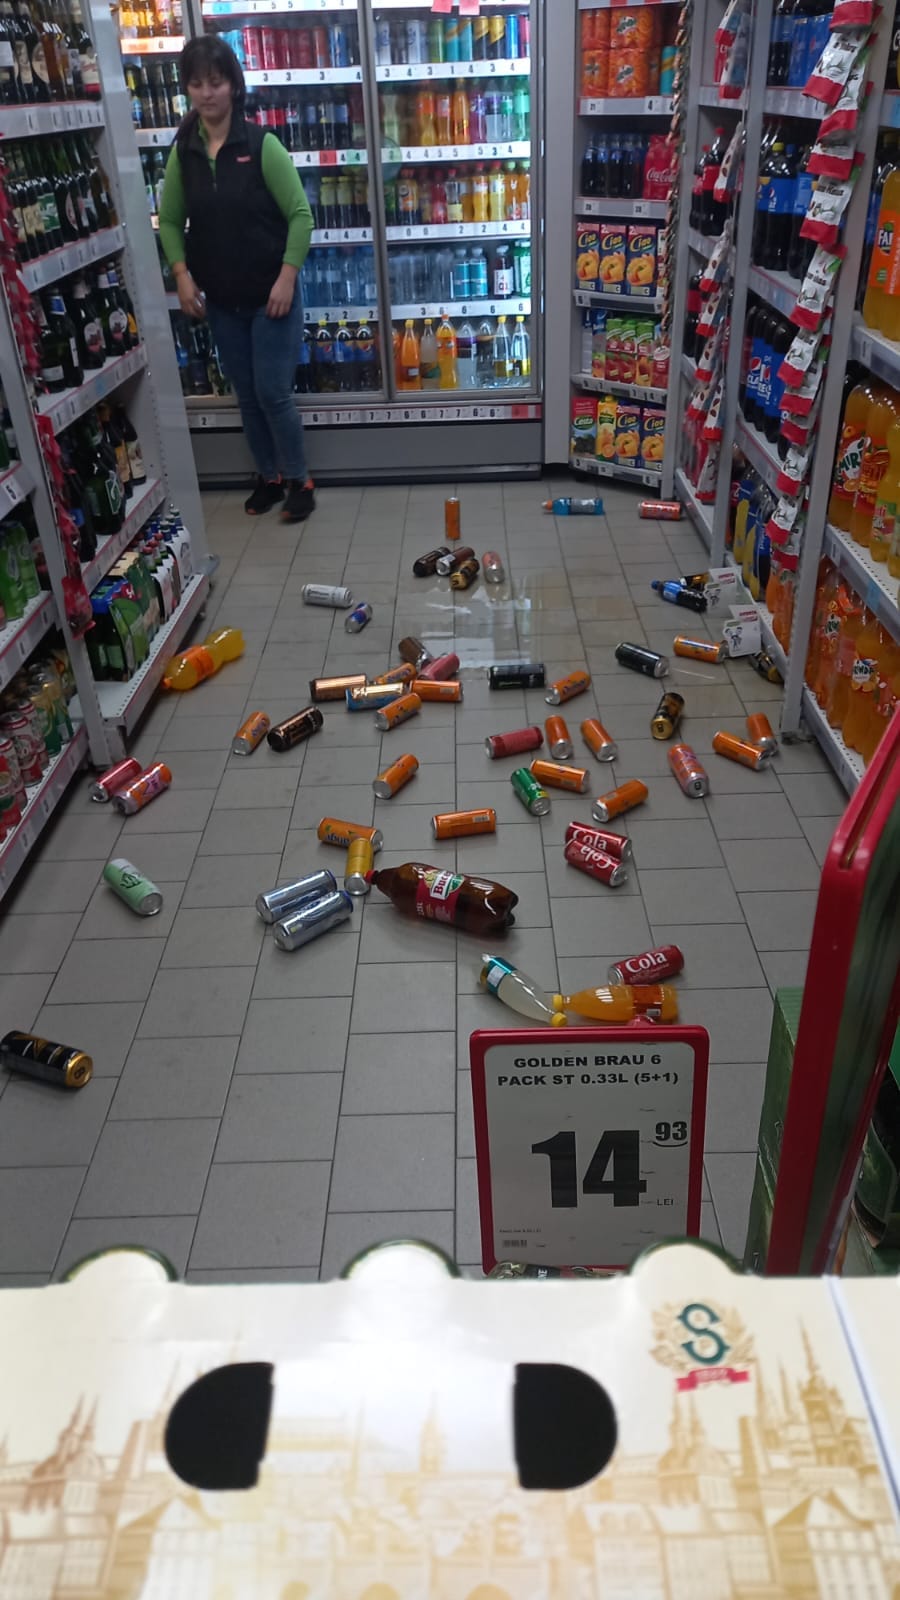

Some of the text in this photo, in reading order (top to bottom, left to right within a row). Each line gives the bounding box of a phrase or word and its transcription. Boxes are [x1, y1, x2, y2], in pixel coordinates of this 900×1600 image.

[625, 951, 667, 974] Cola
[514, 1054, 661, 1069] GOLDEN BRAU 6
[498, 1072, 679, 1086] PACK ST 0.33L (5+1)
[655, 1121, 688, 1142] 93
[531, 1130, 647, 1208] 14
[677, 1303, 731, 1365] S
